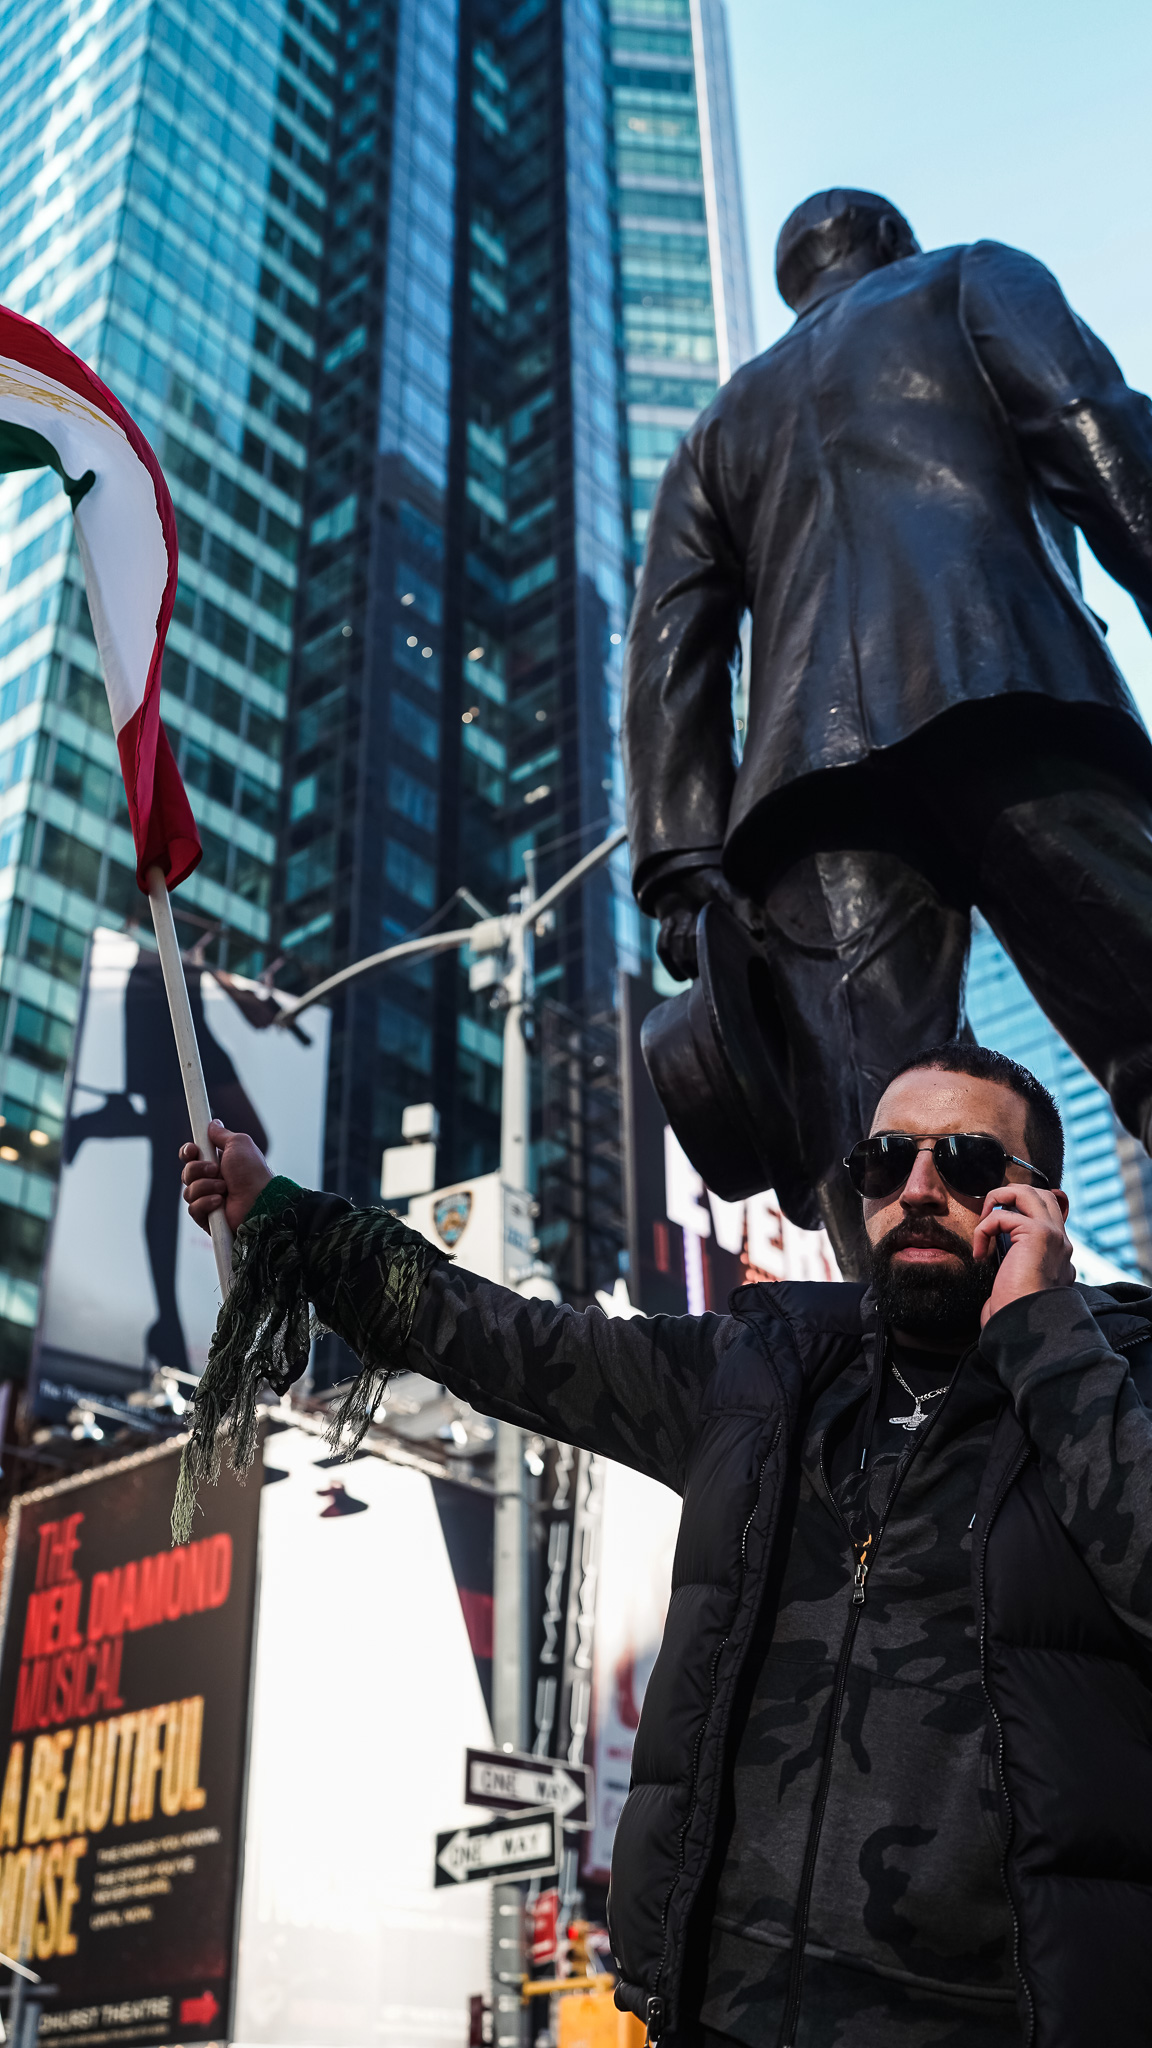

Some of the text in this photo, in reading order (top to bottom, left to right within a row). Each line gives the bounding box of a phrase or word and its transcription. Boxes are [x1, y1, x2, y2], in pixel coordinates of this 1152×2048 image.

[35, 1512, 85, 1592] THE
[22, 1532, 232, 1658] NEIL DIAMOND
[11, 1635, 125, 1734] MUSICAL
[0, 1695, 207, 1848] A BEAUTIFUL
[481, 1767, 517, 1796] ONE
[534, 1779, 571, 1804] WAY
[450, 1829, 540, 1870] ONE WAY
[102, 1997, 171, 2024] THEATRE
